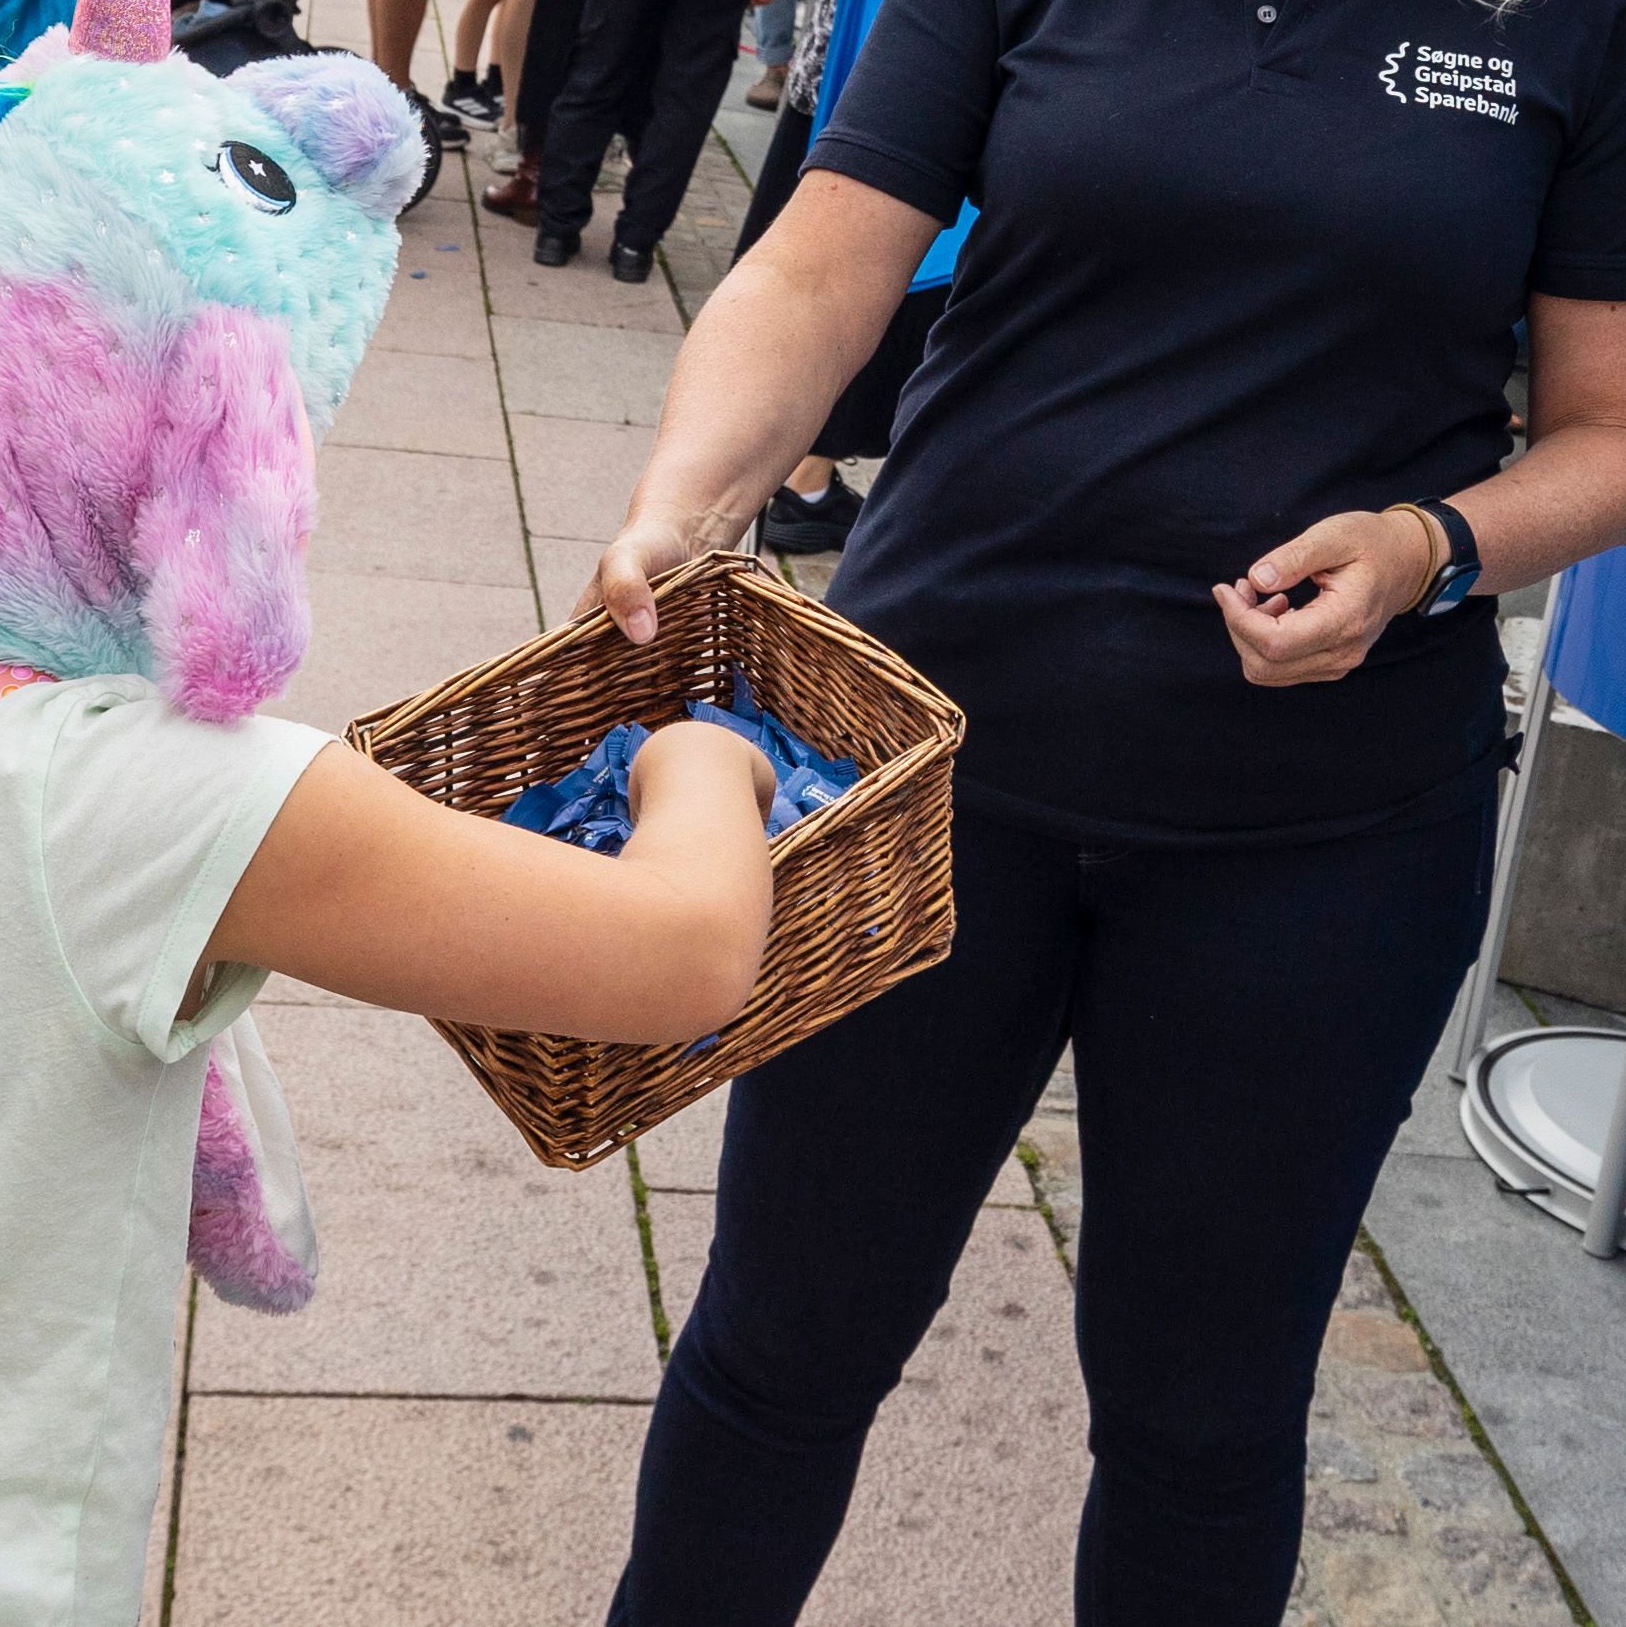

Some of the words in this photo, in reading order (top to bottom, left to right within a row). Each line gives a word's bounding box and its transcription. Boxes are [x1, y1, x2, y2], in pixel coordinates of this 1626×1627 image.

[1416, 46, 1483, 69] Søgne
[1487, 57, 1513, 78] og
[1414, 66, 1517, 97] Greipstad
[1414, 86, 1519, 125] Sparebank
